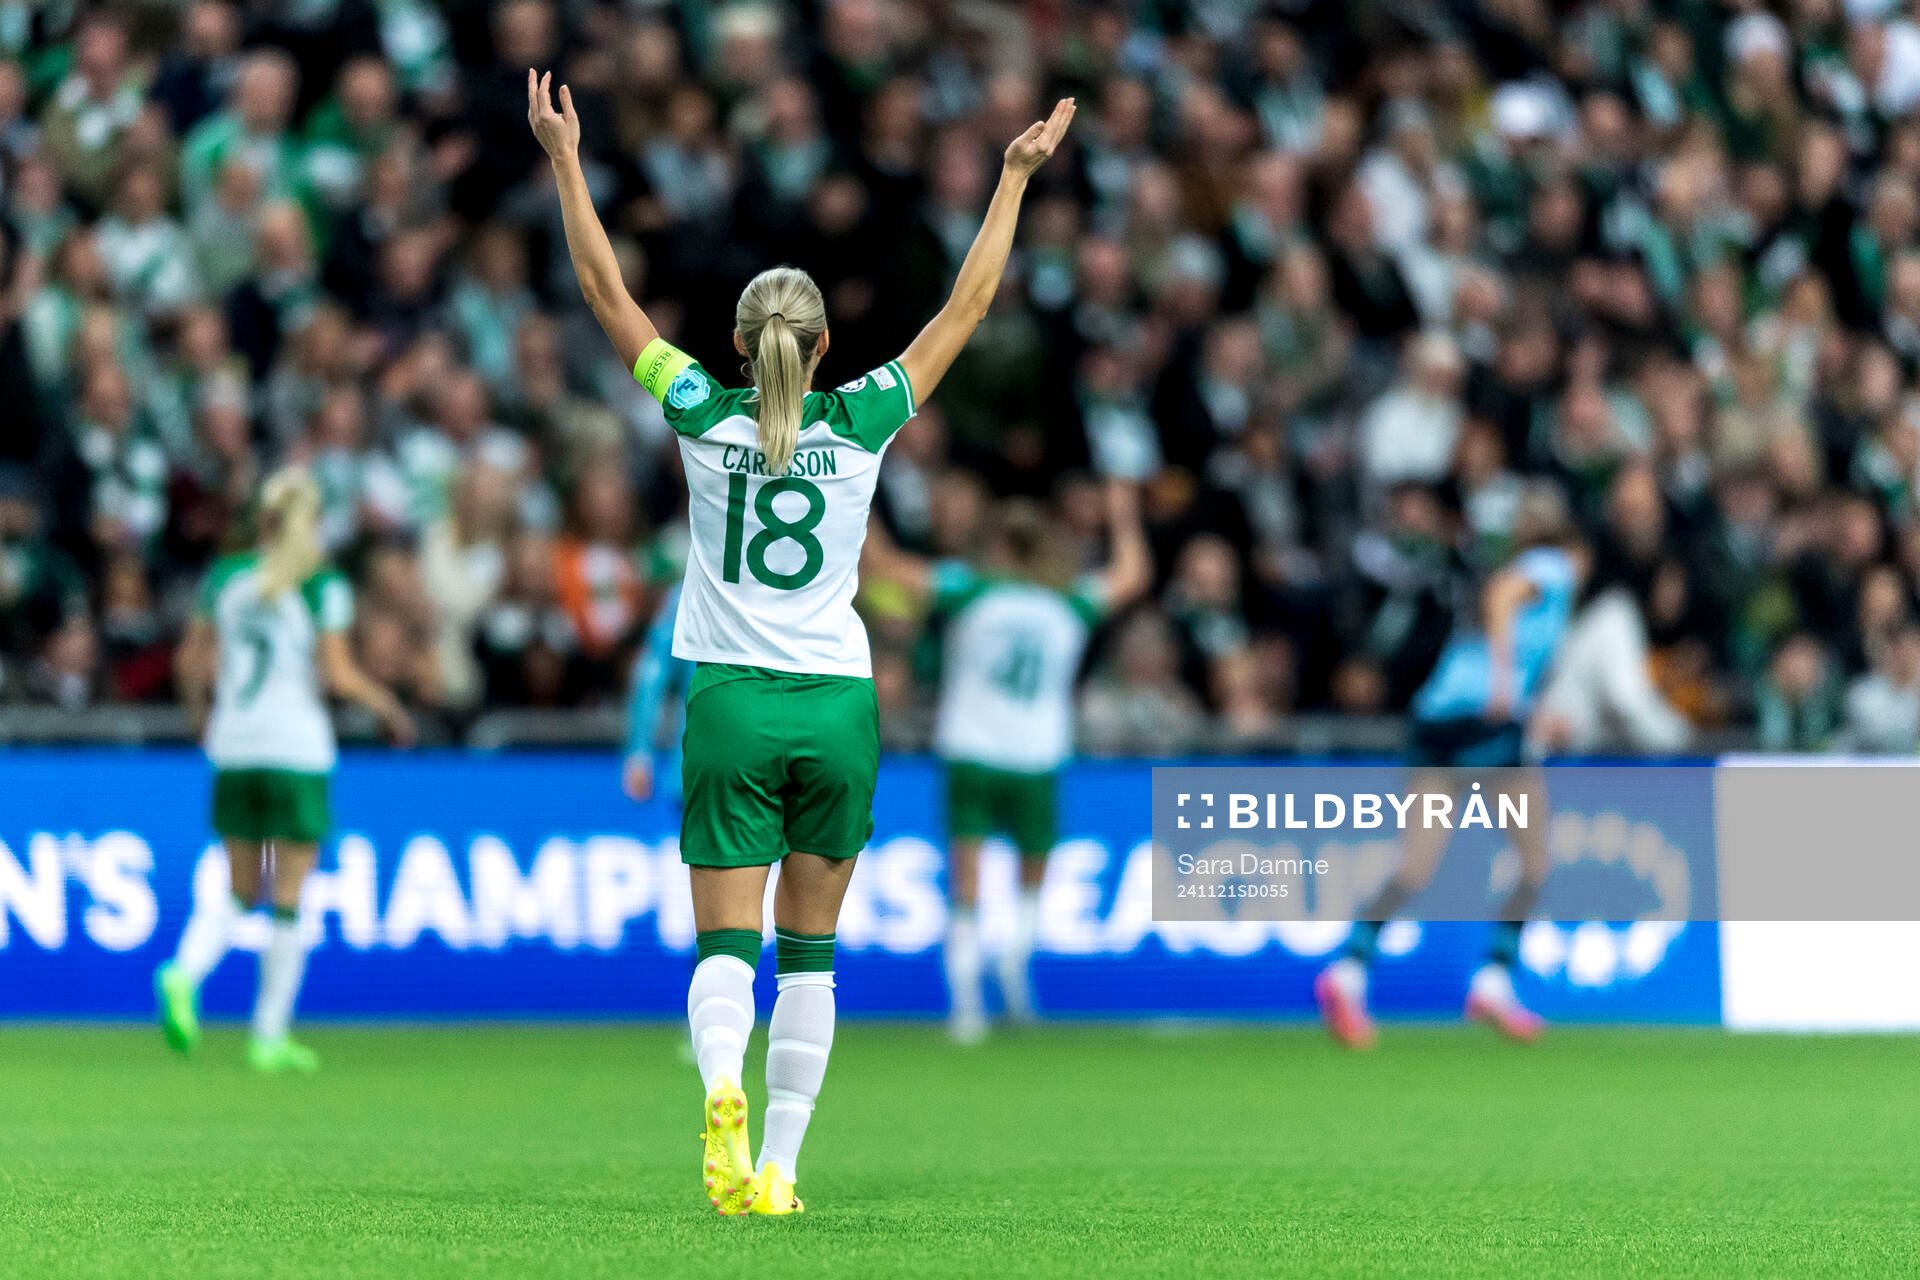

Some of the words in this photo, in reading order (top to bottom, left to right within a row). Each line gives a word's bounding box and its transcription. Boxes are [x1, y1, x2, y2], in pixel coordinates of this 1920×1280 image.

[722, 444, 837, 477] CARSON
[723, 471, 826, 590] 18
[191, 836, 945, 953] HAMPIS
